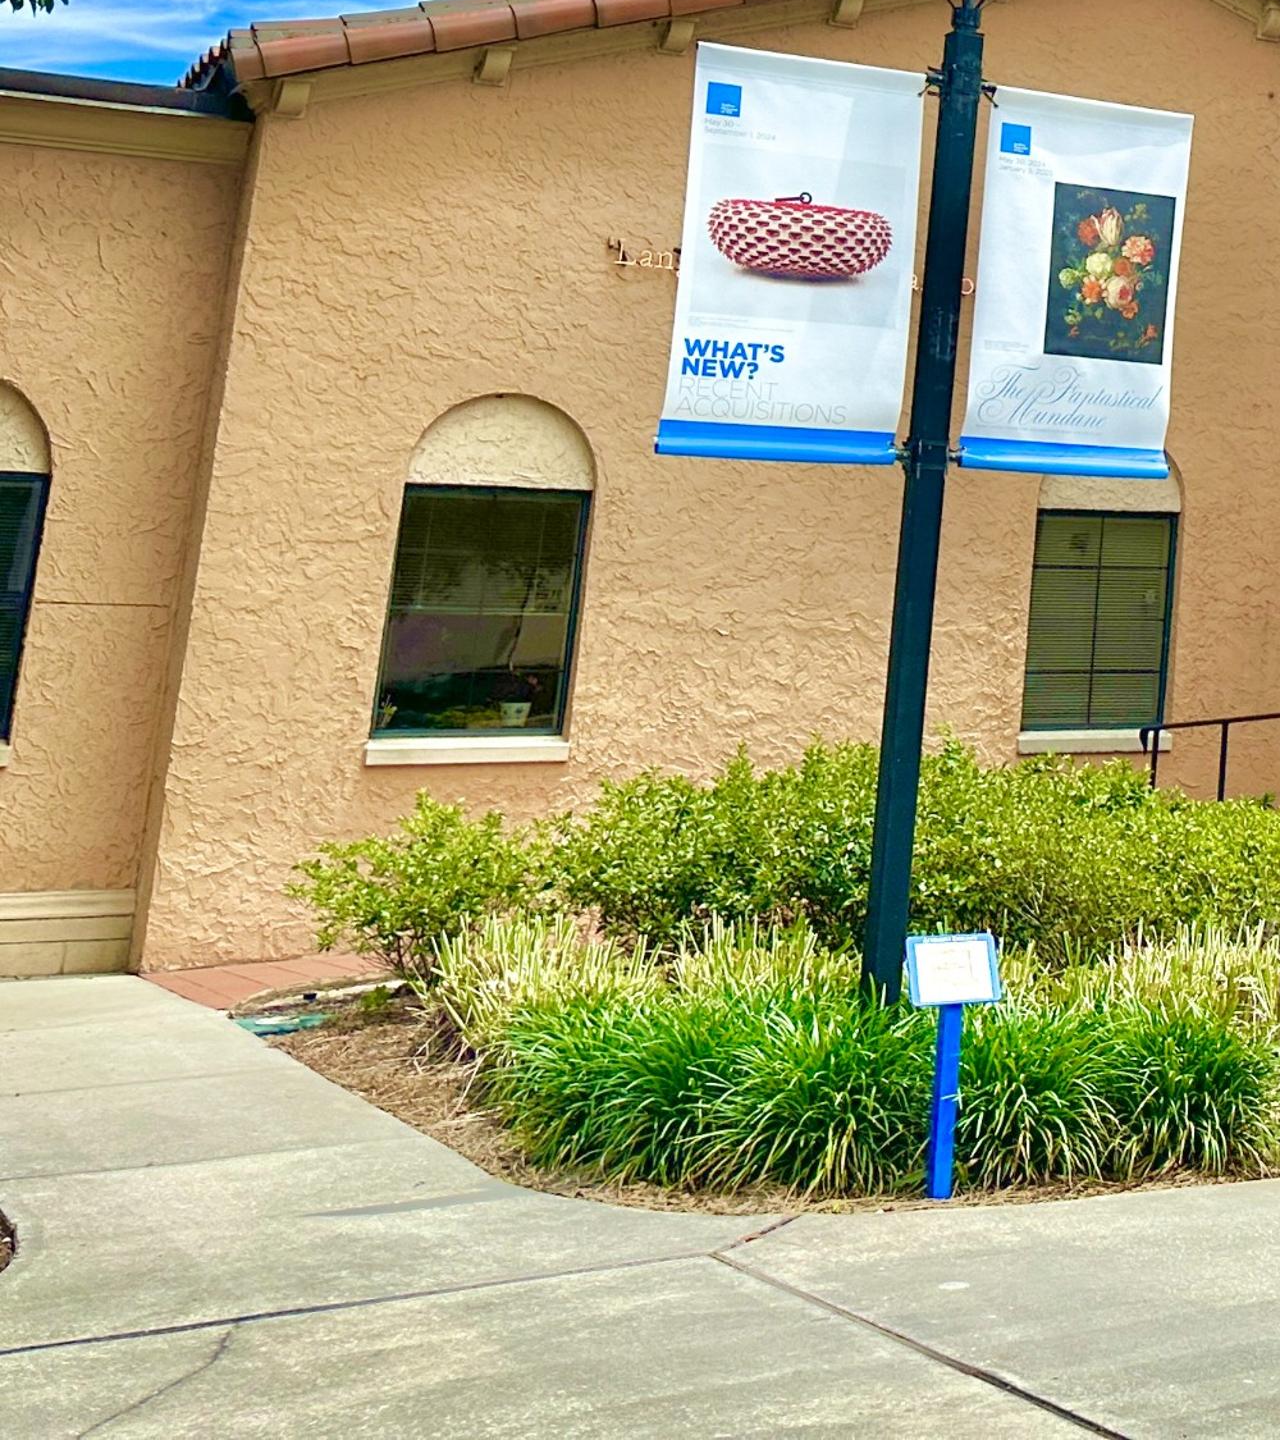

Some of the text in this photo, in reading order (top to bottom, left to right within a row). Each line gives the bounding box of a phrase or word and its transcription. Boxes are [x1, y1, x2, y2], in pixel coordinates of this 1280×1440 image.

[684, 338, 785, 363] WHAT'S
[681, 357, 759, 380] NEW?
[678, 377, 779, 401] RECENT
[975, 363, 1164, 410] The Fantastical
[674, 396, 848, 425] ACQUISITIONS
[977, 388, 1107, 428] Mundane
